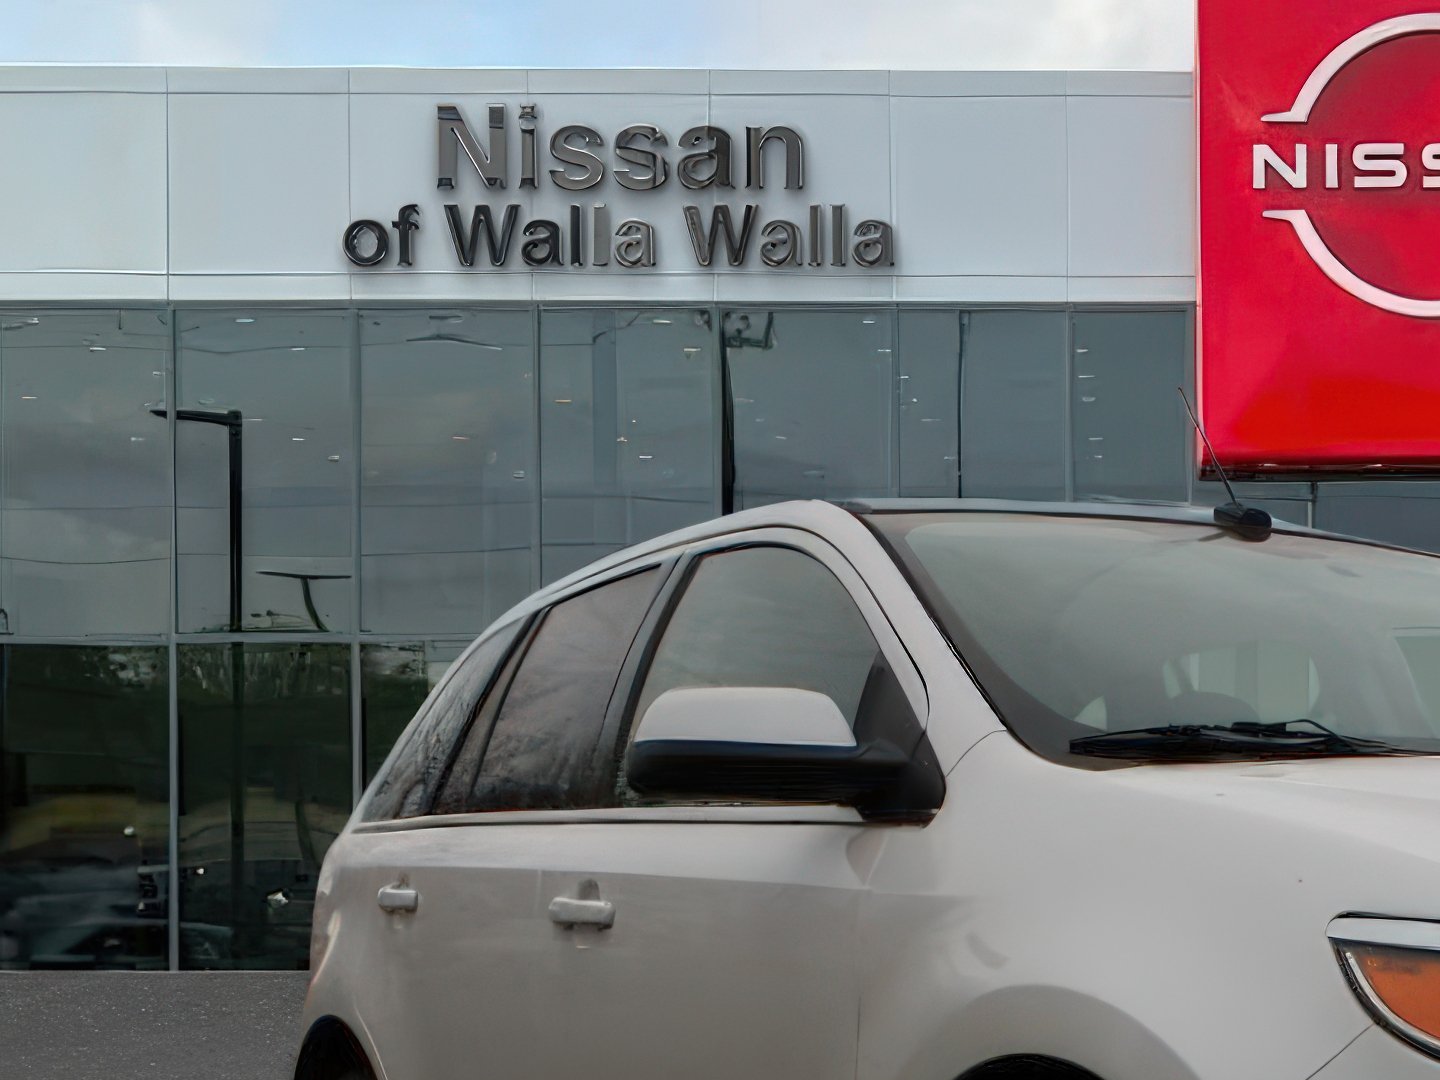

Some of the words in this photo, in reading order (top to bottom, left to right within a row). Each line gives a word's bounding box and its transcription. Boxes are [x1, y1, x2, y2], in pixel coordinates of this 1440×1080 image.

[437, 102, 804, 190] Nissan
[342, 203, 421, 267] of
[444, 203, 659, 267] Walla
[683, 203, 895, 267] Walla
